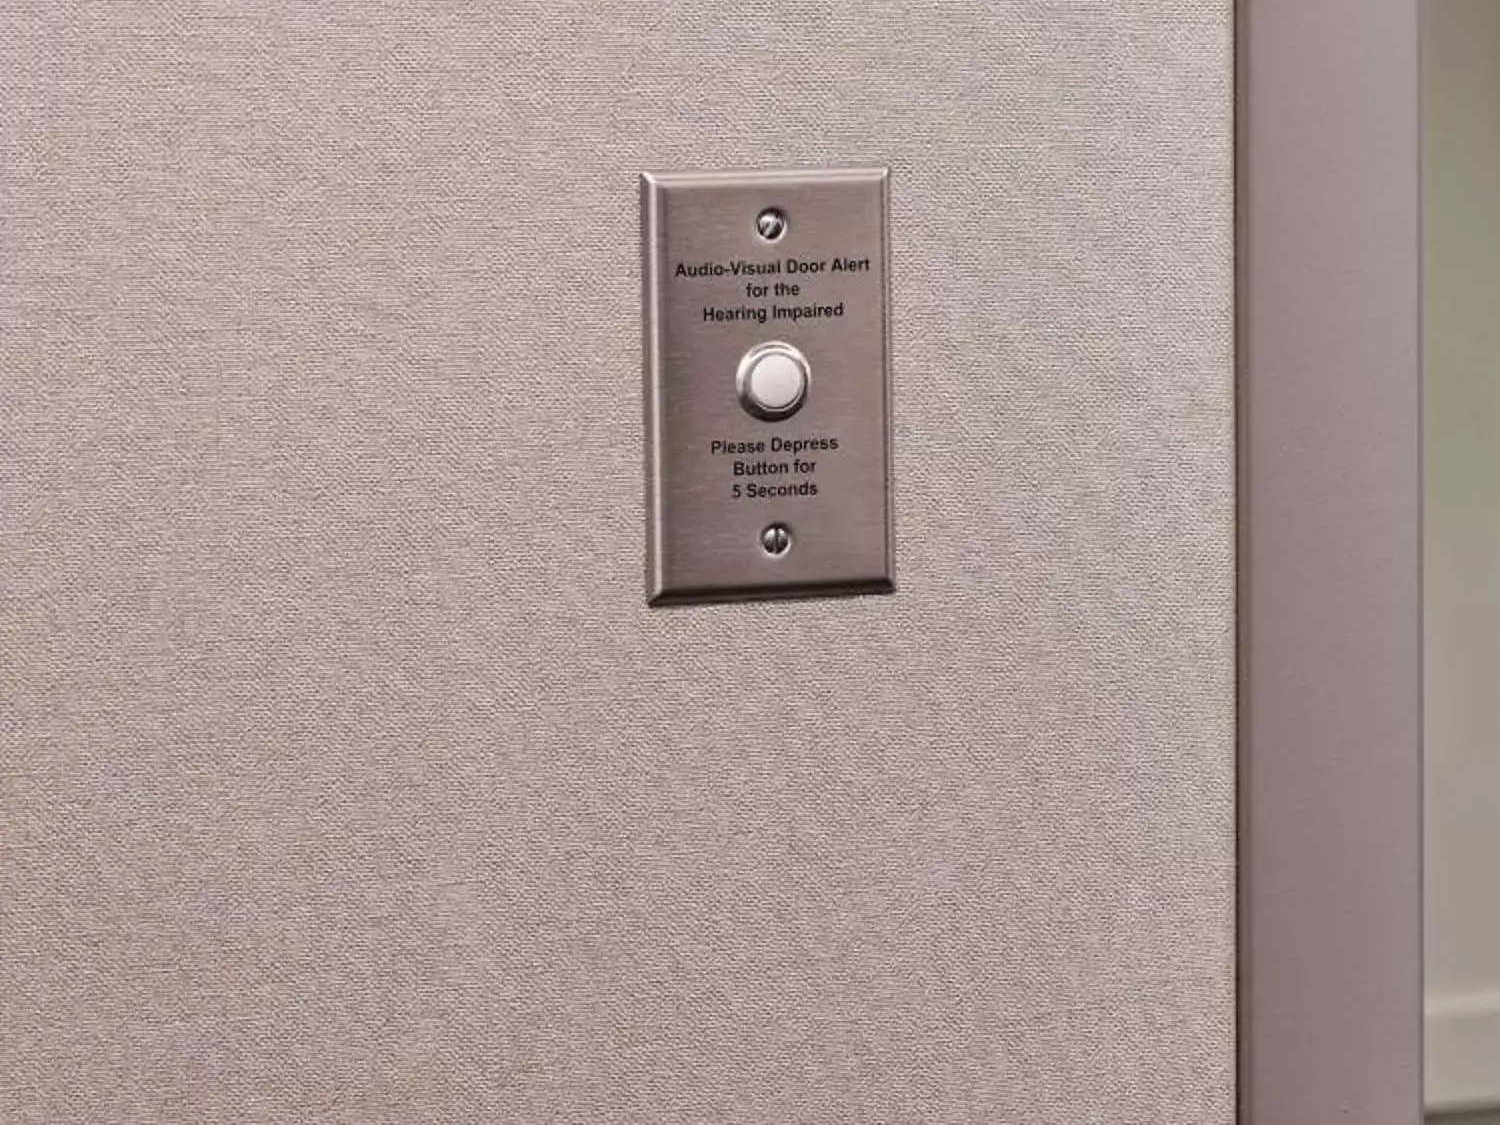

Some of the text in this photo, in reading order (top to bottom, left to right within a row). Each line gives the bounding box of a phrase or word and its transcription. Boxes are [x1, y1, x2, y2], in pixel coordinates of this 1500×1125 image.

[673, 256, 871, 278] Audio-Visual Door Alert
[745, 282, 801, 298] for the
[702, 301, 845, 324] Hearing Impaired
[710, 436, 840, 456] Please Depress
[733, 458, 817, 477] Button for
[731, 480, 819, 499] 5 Seconds
